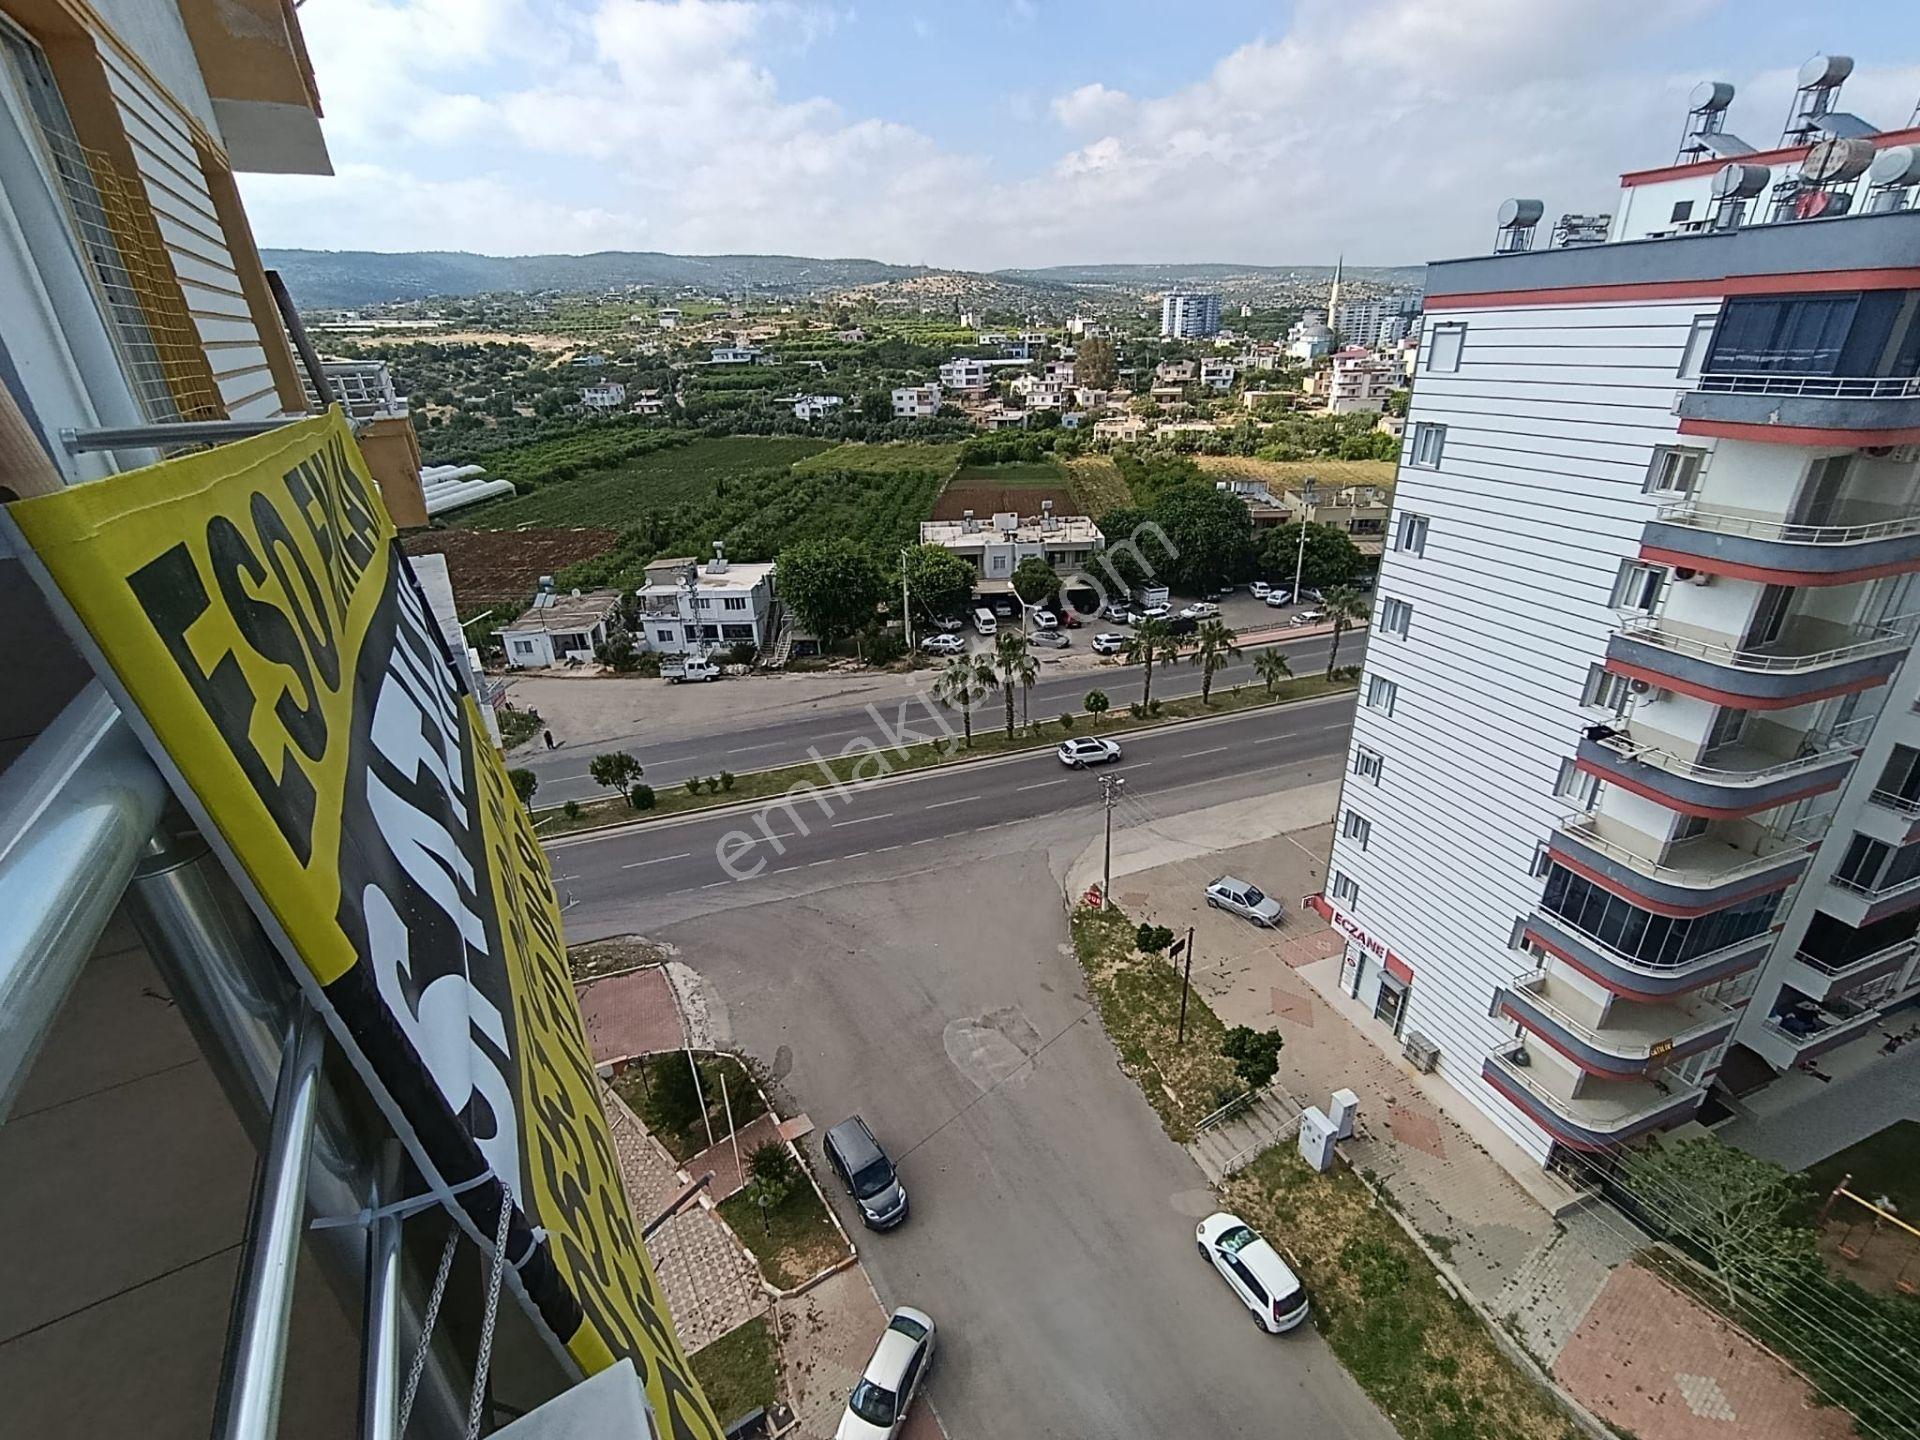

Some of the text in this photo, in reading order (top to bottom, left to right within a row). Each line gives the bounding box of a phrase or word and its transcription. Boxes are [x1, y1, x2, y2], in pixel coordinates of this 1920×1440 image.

[125, 491, 341, 870] ESO
[363, 556, 524, 1214] SATILIK
[1334, 911, 1385, 959] ECZANE
